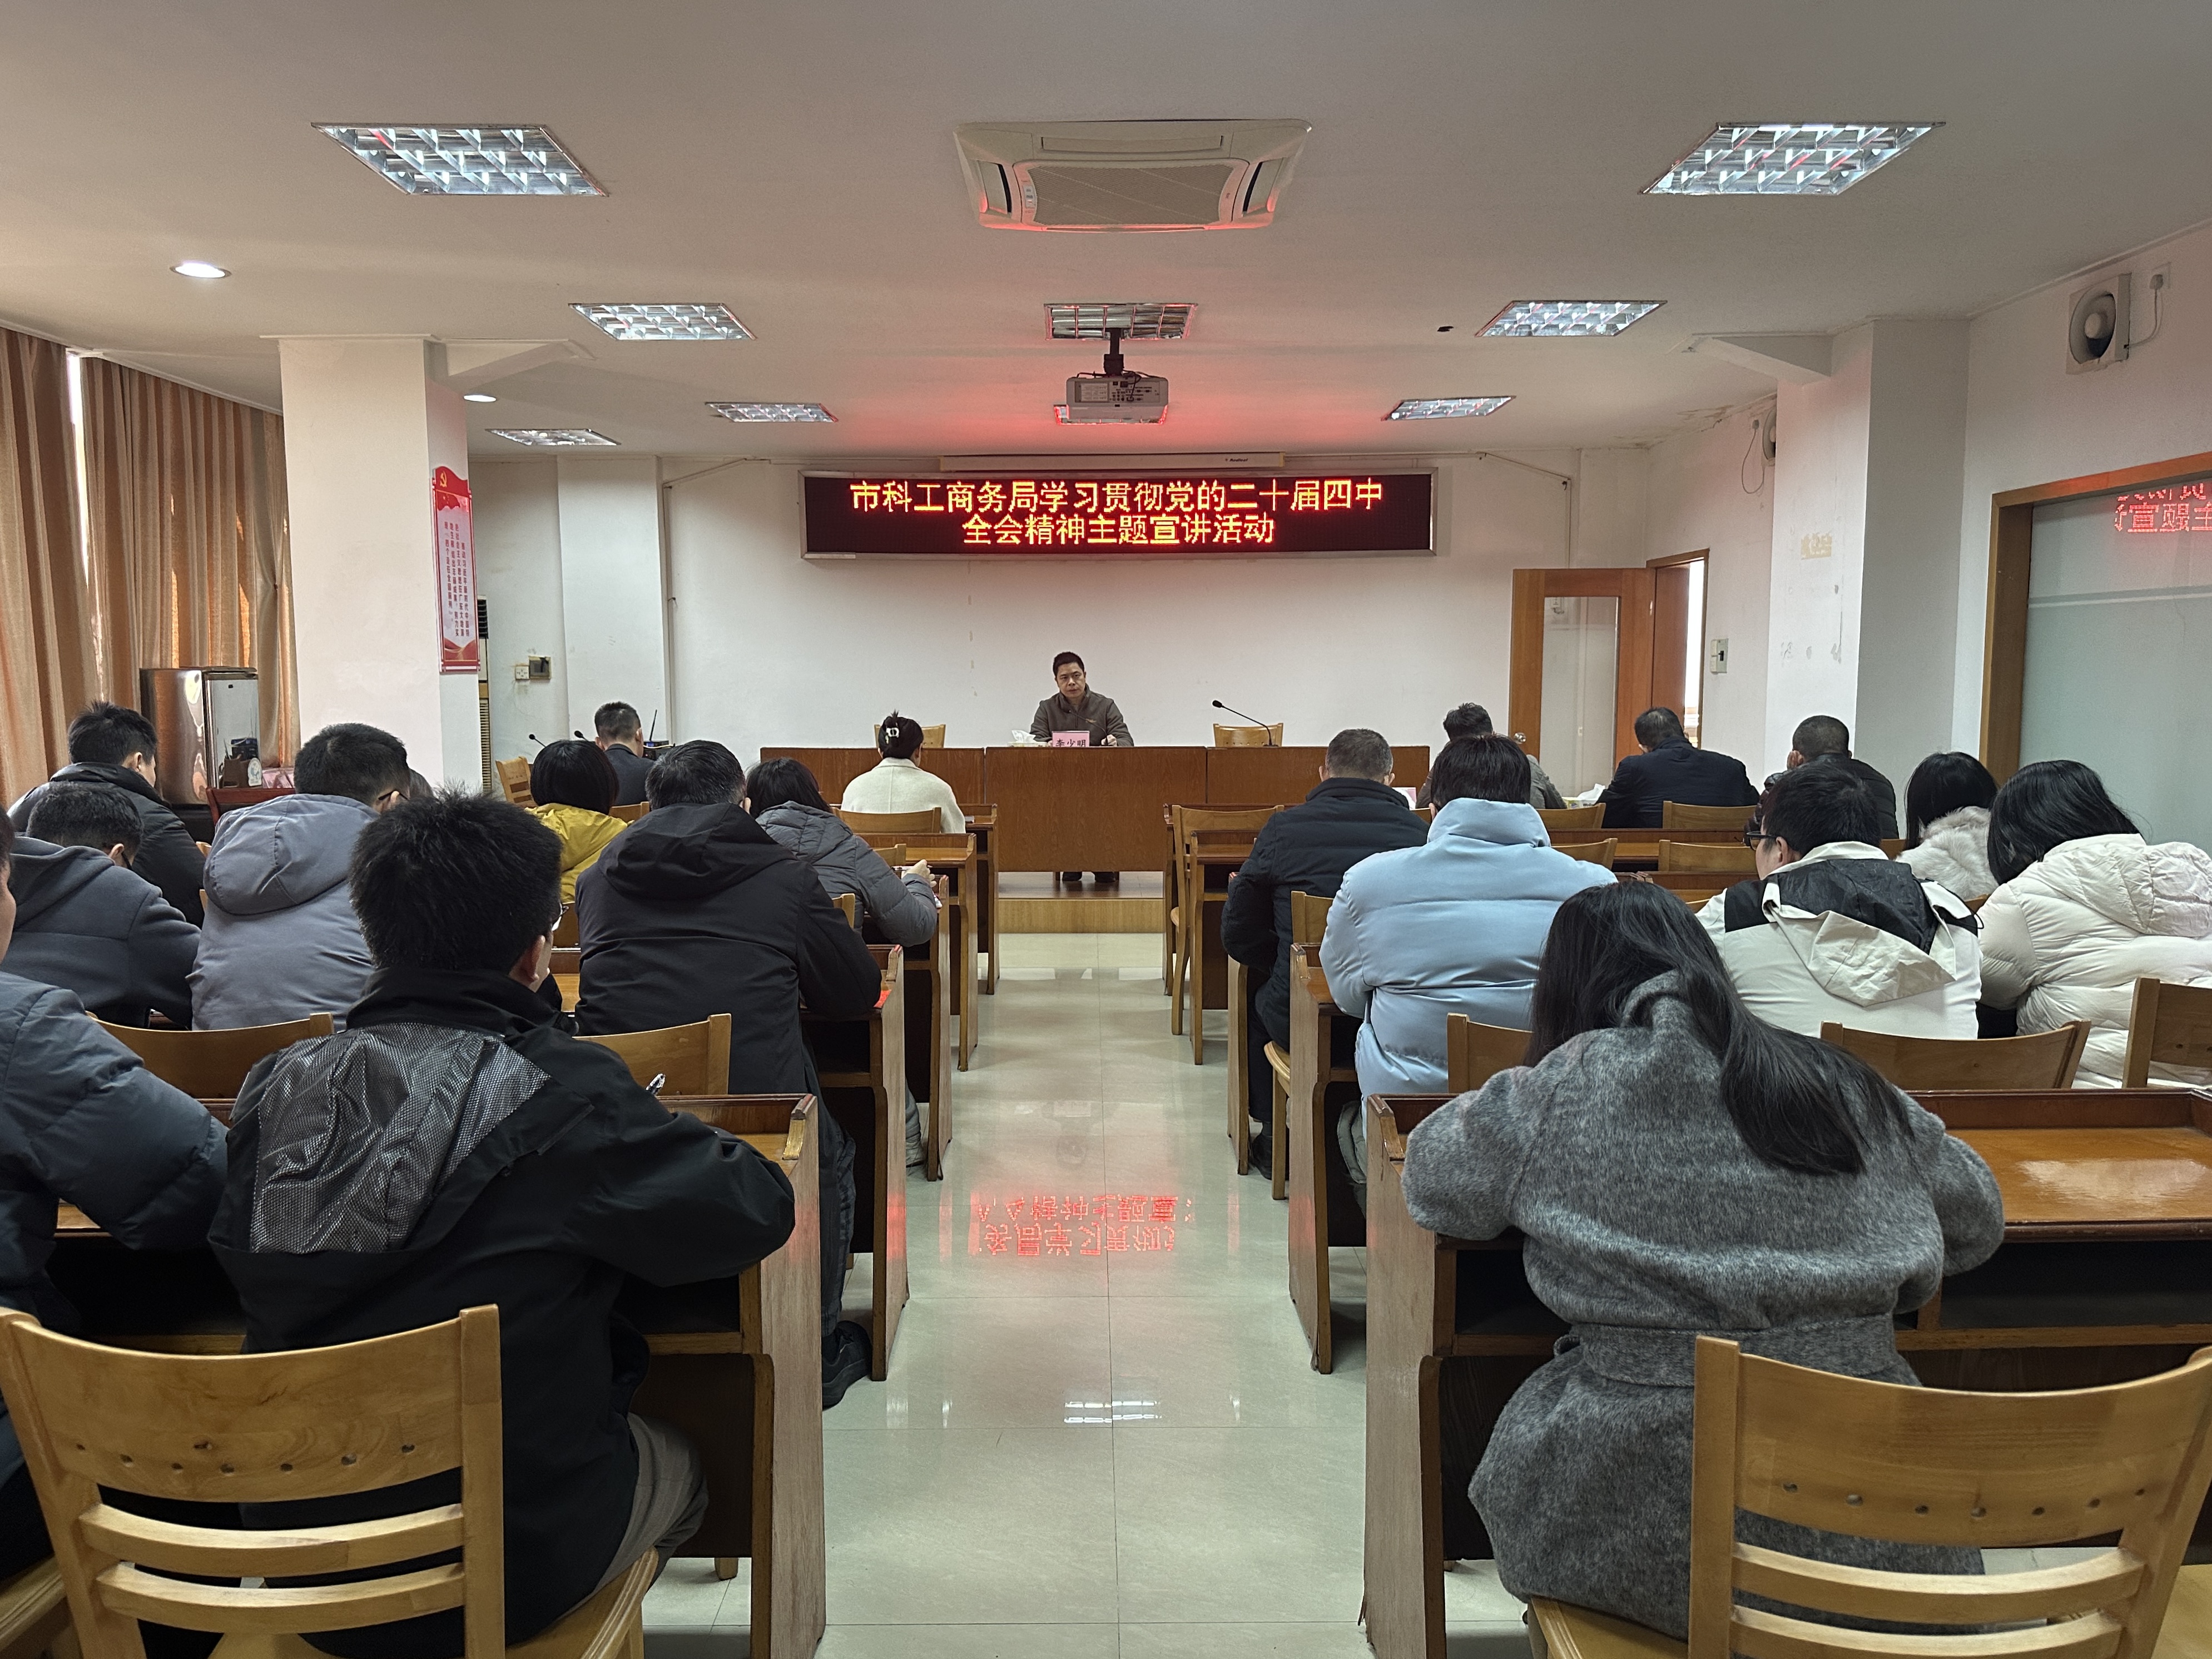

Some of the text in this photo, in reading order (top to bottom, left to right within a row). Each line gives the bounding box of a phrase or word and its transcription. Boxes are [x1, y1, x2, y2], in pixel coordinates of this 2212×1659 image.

[850, 478, 1382, 513] 市科工商务局学习贯彻党的二十届四中
[962, 512, 1274, 545] 全会精神主题宣讲活动
